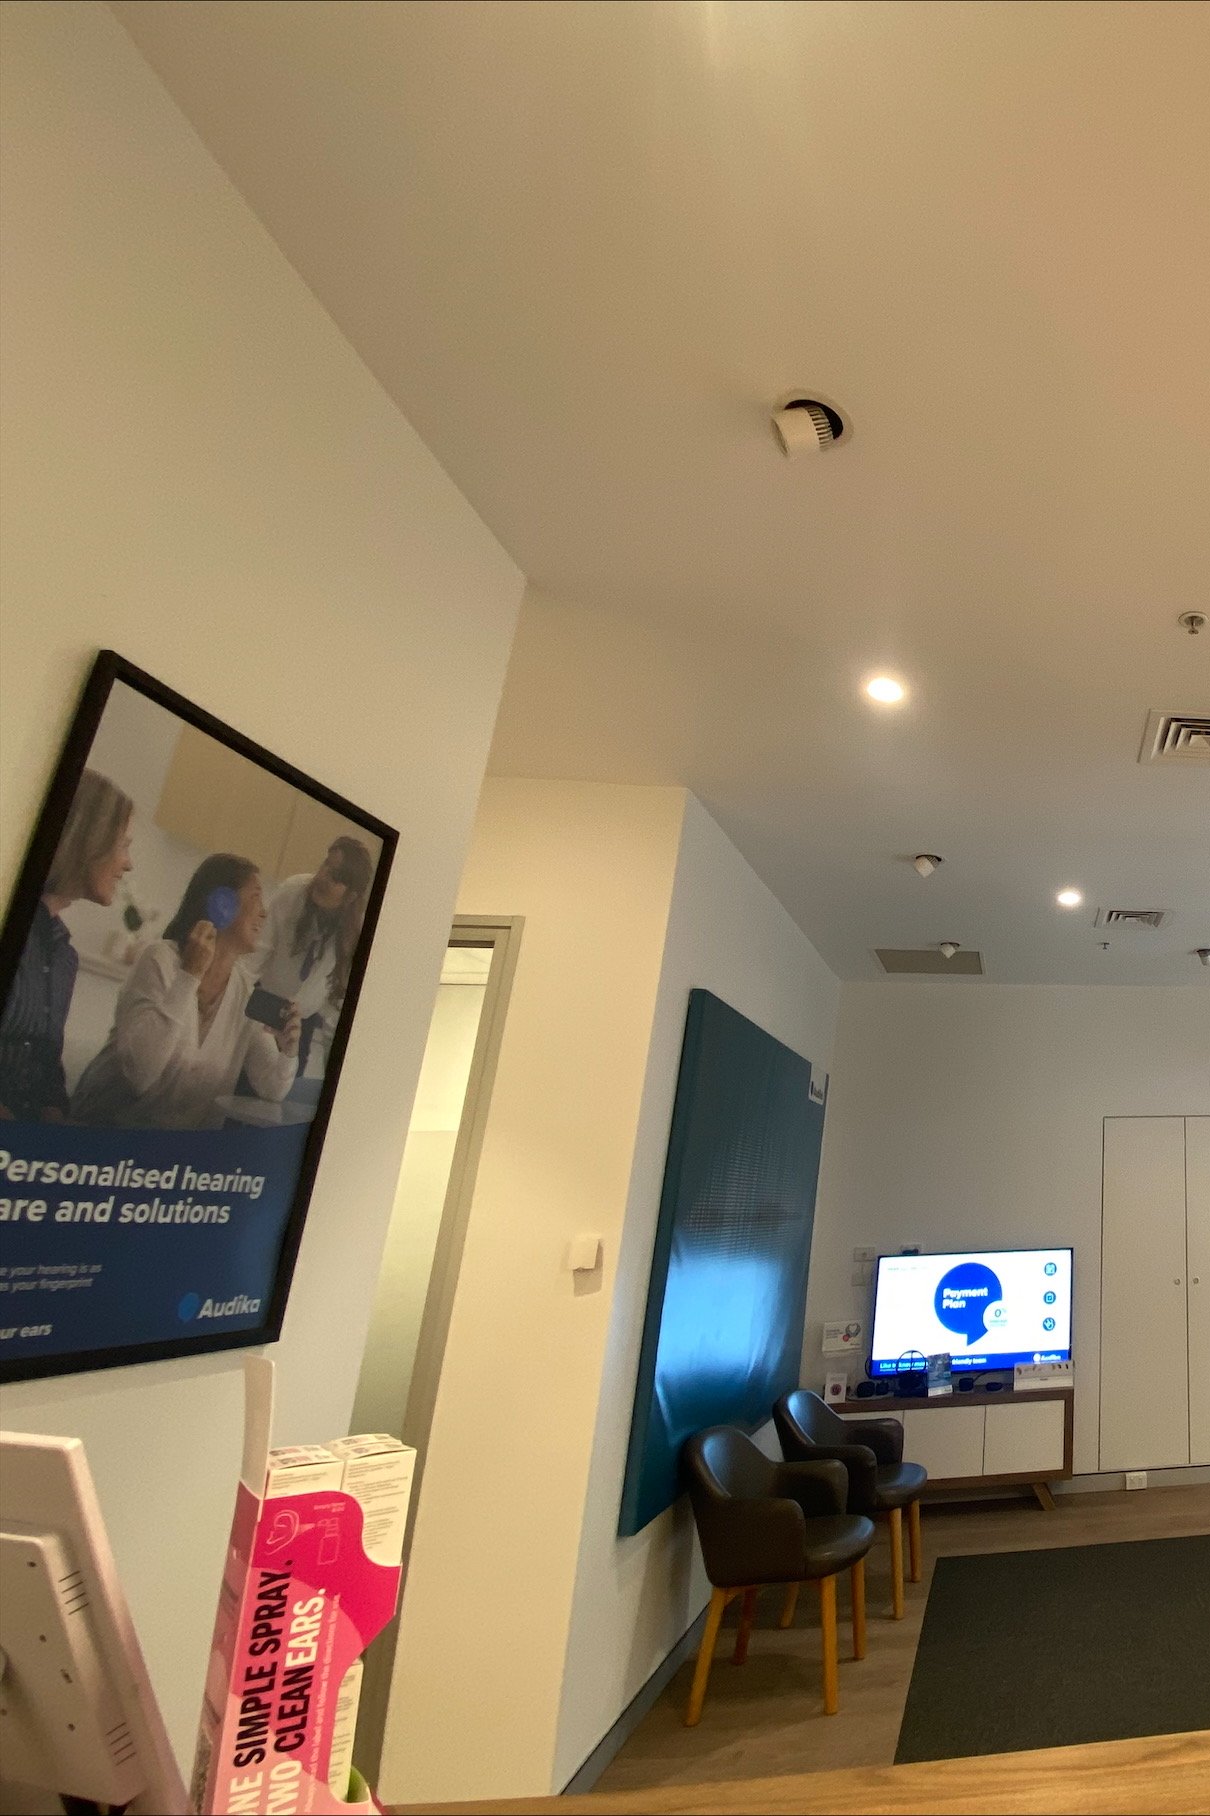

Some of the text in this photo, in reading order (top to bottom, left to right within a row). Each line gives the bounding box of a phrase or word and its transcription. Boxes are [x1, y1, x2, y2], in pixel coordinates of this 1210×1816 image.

[181, 1165, 265, 1199] hearing
[0, 1196, 231, 1224] are and solutions
[942, 1287, 989, 1300] Payment
[942, 1299, 967, 1310] Plan
[196, 1295, 261, 1319] Audika
[20, 1324, 53, 1338] ears
[226, 1560, 293, 1815] NE SIMPLE SPRAY.
[266, 1760, 302, 1815] TWO
